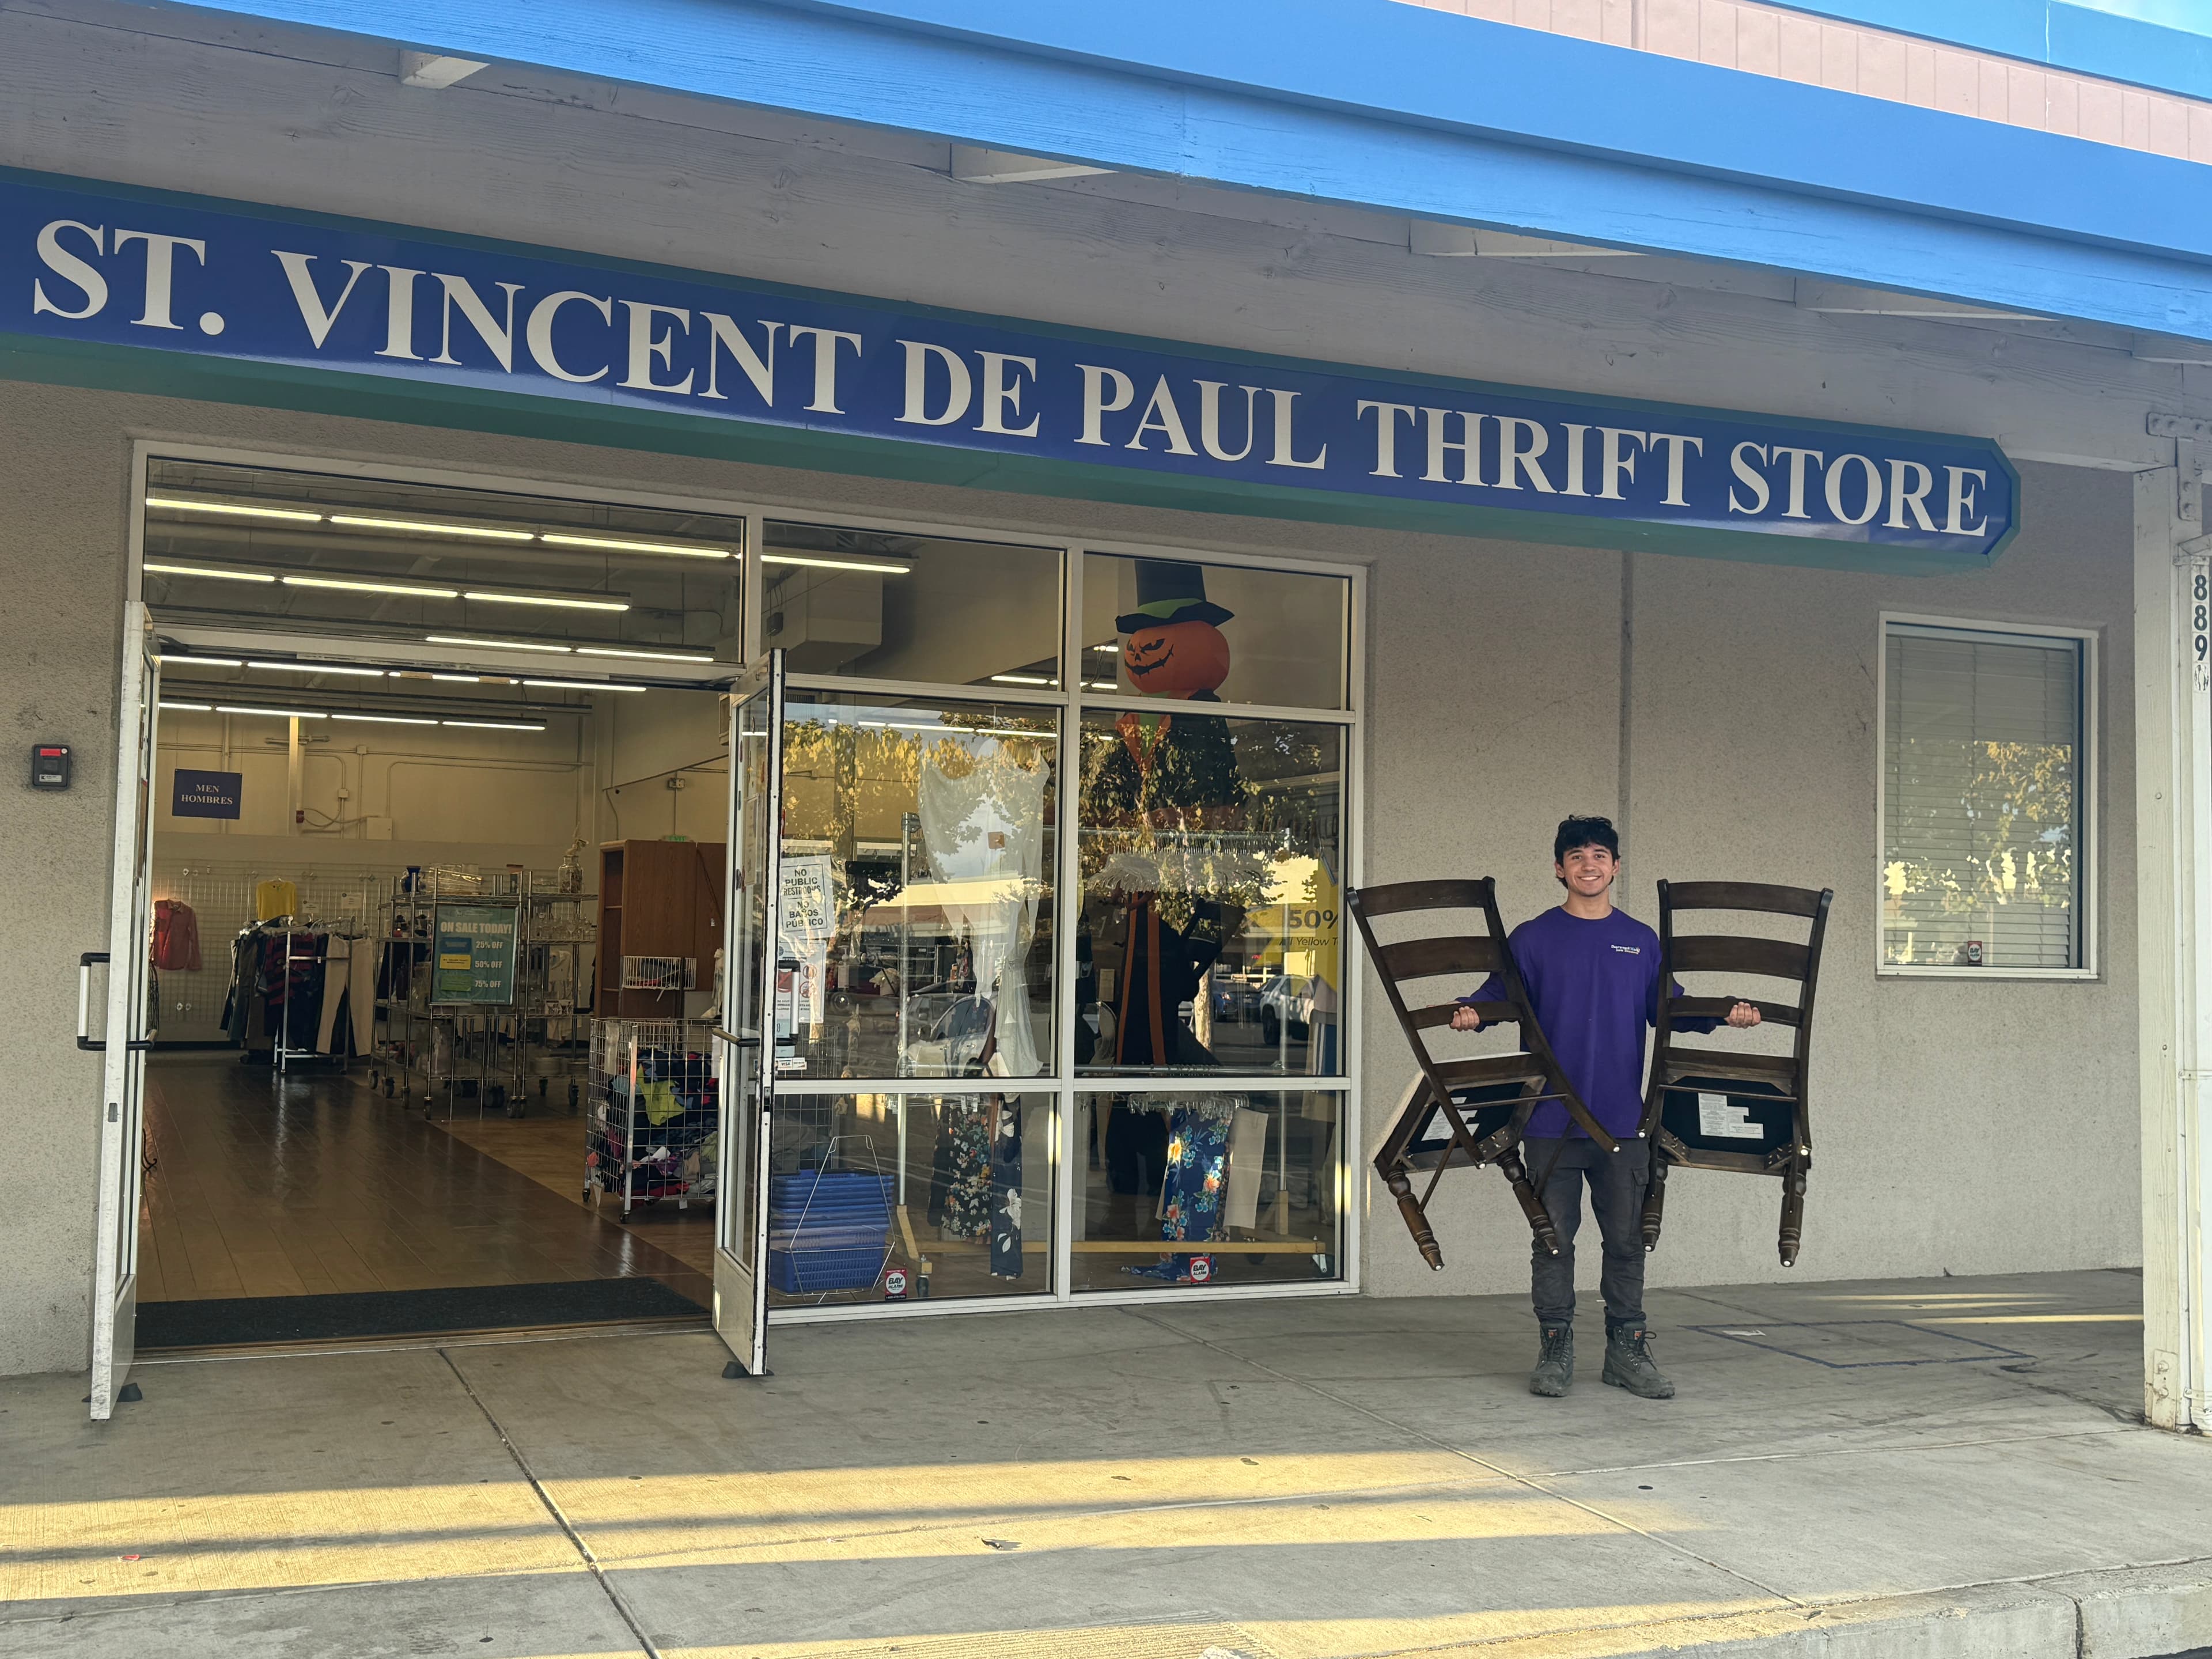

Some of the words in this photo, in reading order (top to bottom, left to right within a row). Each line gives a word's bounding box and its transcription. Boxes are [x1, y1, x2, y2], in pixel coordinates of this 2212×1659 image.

[34, 220, 225, 335] ST.
[271, 250, 862, 414] VINCENT
[893, 339, 1040, 437] DE
[1073, 363, 1327, 469] PAUL
[1357, 400, 1703, 506] THRIFT
[1729, 441, 1987, 537] STORE
[196, 784, 219, 793] MEN
[181, 794, 233, 805] HOMBRES
[785, 877, 817, 886] PUBLIC
[783, 885, 821, 896] RESTOOS
[797, 900, 809, 908] NO
[786, 918, 823, 928] PÚBICO
[1289, 910, 1338, 929] 50%
[440, 922, 454, 933] ON
[456, 922, 478, 933] SALE
[479, 923, 512, 934] TODAY!
[1279, 937, 1293, 945] Al
[1297, 937, 1330, 945] Yellow
